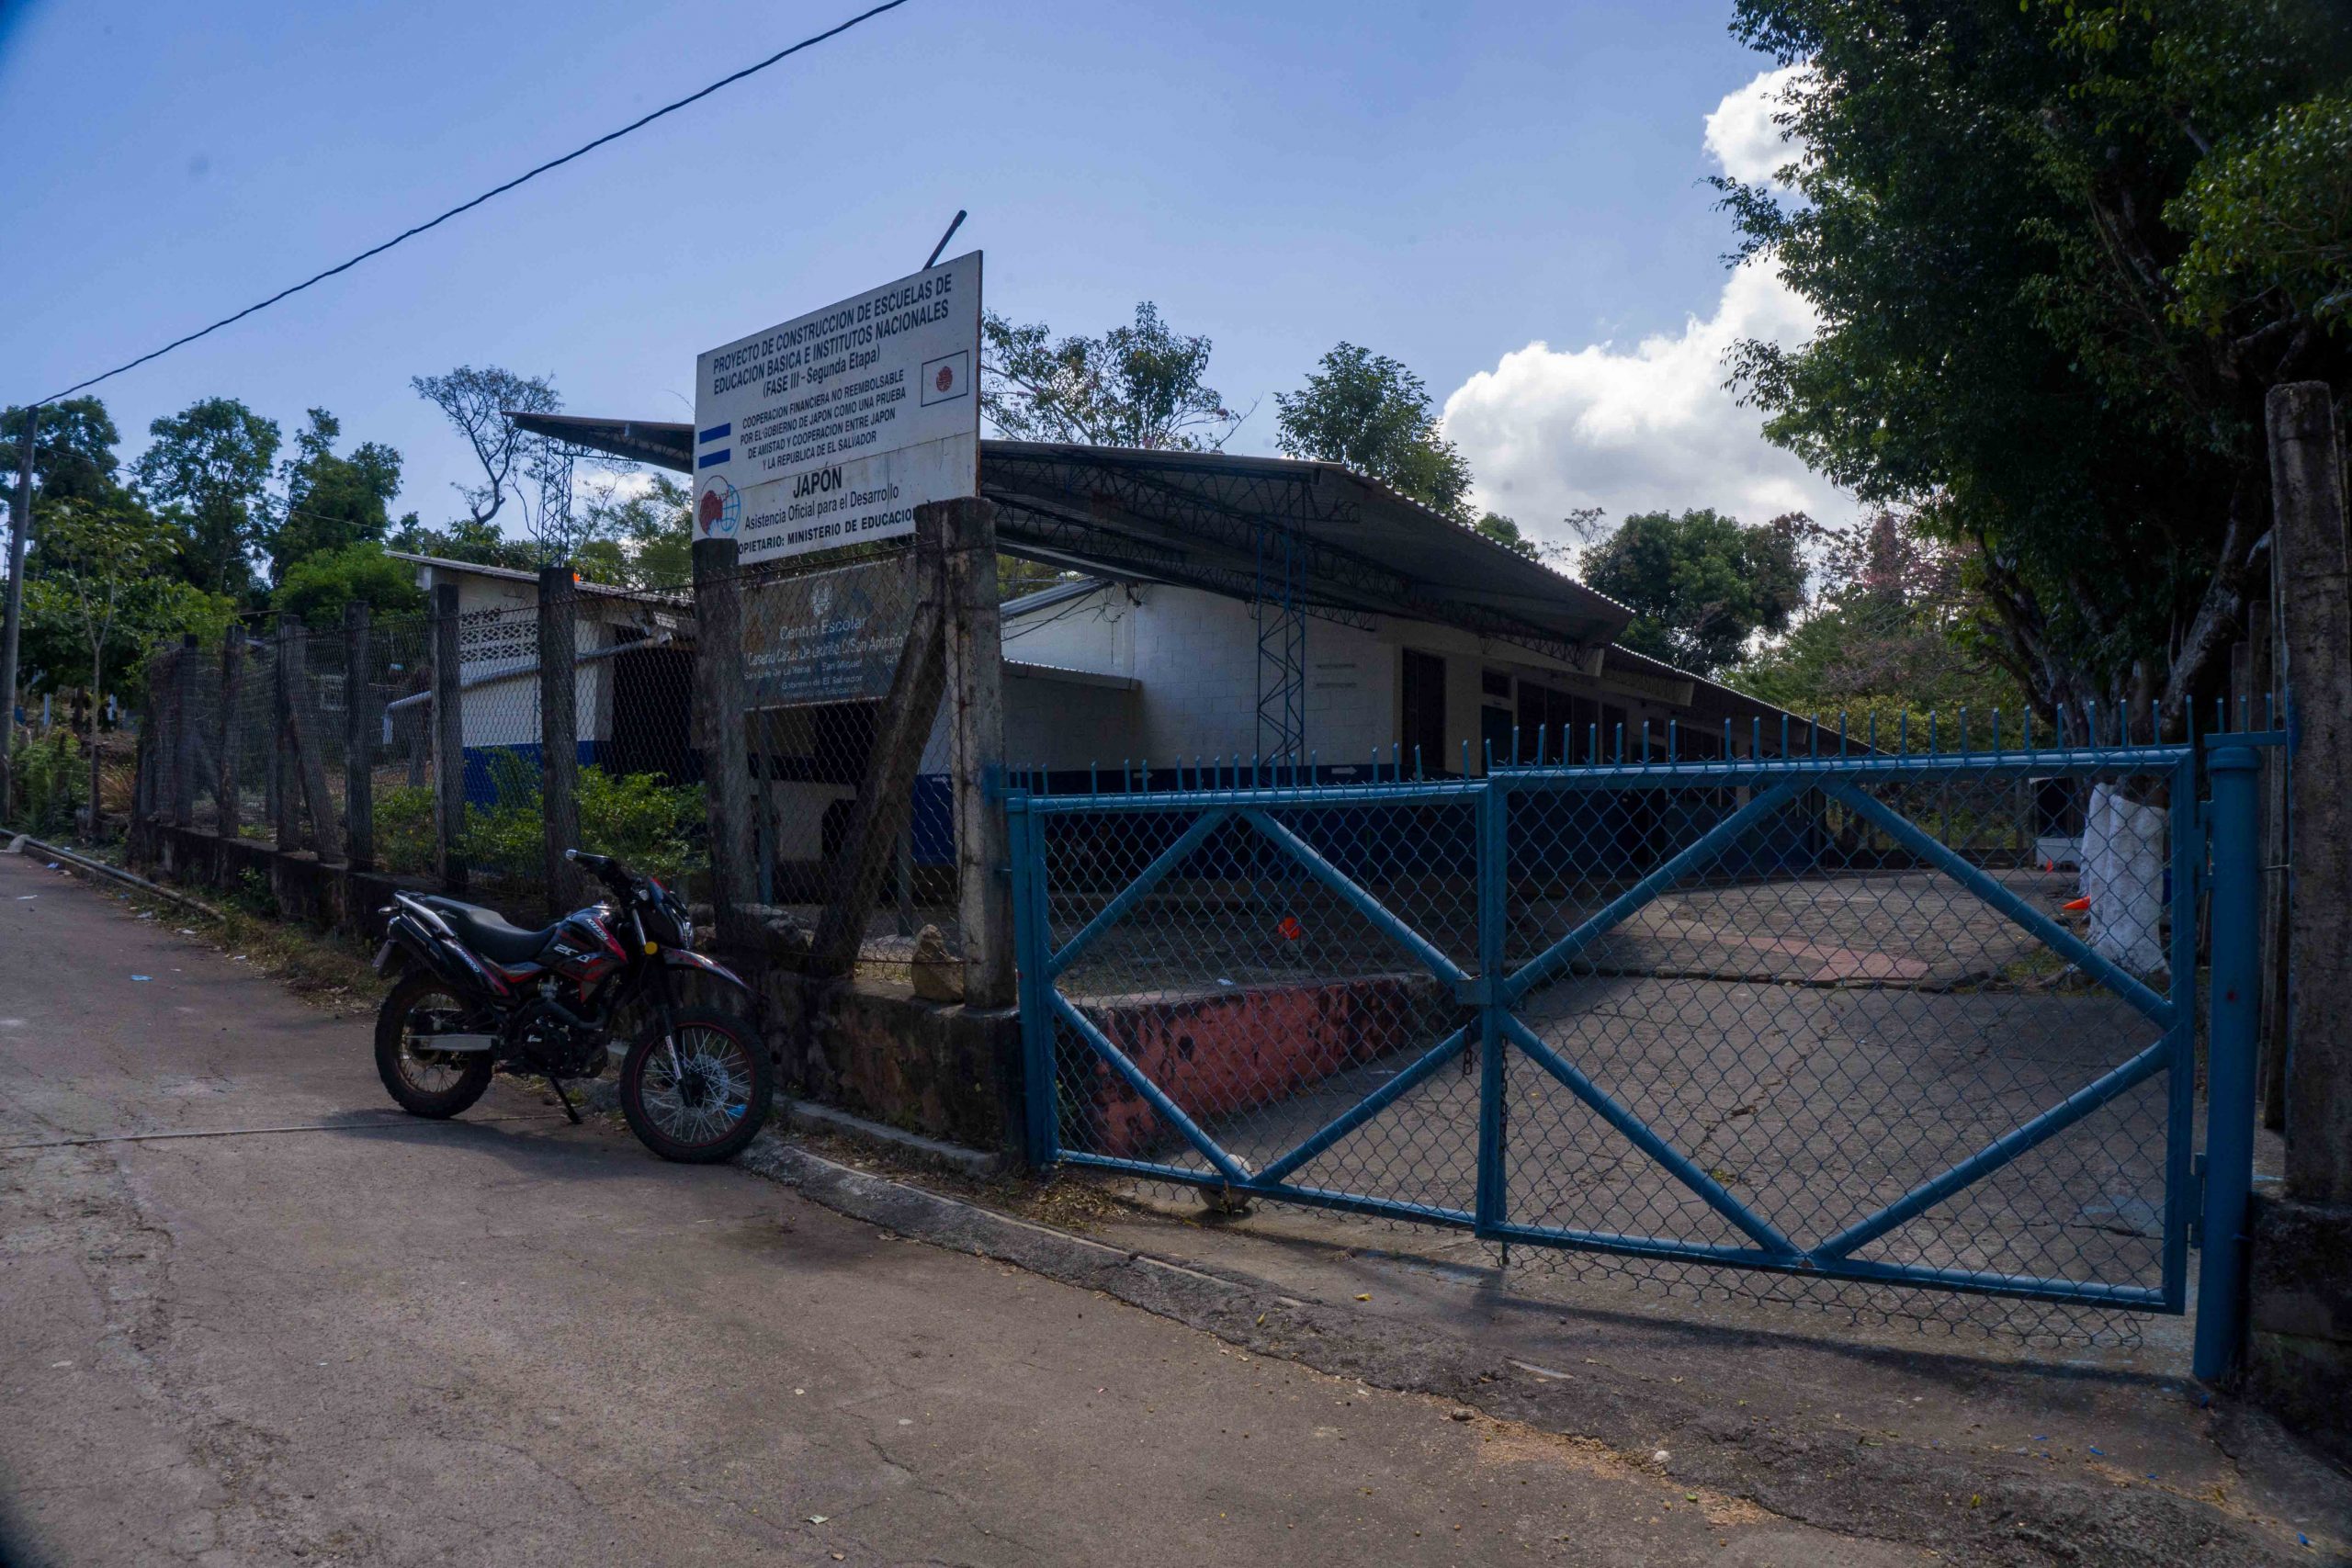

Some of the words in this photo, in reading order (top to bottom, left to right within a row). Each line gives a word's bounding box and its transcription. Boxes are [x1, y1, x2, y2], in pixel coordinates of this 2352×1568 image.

[713, 344, 760, 375] PROYECTO
[762, 338, 774, 357] DE
[776, 308, 854, 352] CONSTRUCCION
[857, 302, 872, 323] DE
[875, 280, 933, 317] ESCUELAS
[936, 273, 952, 296] DE
[714, 362, 764, 395] EDUCACION
[767, 350, 801, 377] BASICA
[805, 346, 810, 364] E
[813, 325, 873, 361] INSTITUTOS
[876, 299, 949, 341] NACIONALES
[763, 375, 788, 399] (FASE
[790, 371, 799, 389] III
[807, 357, 846, 384] Segunda
[849, 344, 880, 370] Etapa)
[741, 433, 753, 446] POR
[754, 429, 763, 441] EL
[763, 419, 797, 439] GOBIERNO
[798, 415, 808, 428] DE
[834, 401, 857, 419] COMO
[859, 396, 874, 412] UNA
[876, 387, 906, 406] PRUEBA
[742, 405, 788, 430] COOPERACION
[789, 392, 830, 415] FINANCIERA
[831, 388, 842, 402] NO
[844, 368, 904, 399] REEMBOLSABLE
[748, 447, 757, 459] DE
[757, 438, 786, 456] AMISTAD
[786, 435, 792, 448] Y
[792, 422, 843, 447] COOPERACION
[845, 414, 869, 433] ENTRE
[763, 458, 767, 471] Y
[768, 457, 775, 469] LA
[777, 446, 815, 468] REPUBLICA
[816, 444, 826, 457] DE
[827, 441, 836, 454] EL
[838, 430, 876, 452] SALVADOR
[738, 536, 785, 555] OPIETARIO:
[787, 523, 841, 545] MINISTERIO
[845, 519, 857, 534] DE
[862, 508, 915, 530] EDUCACIO
[745, 508, 786, 532] Asistencia
[788, 500, 815, 522] Oficial
[818, 499, 837, 519] para
[840, 492, 847, 510] el
[851, 482, 899, 508] Desarrollo
[821, 615, 866, 635] Escolar
